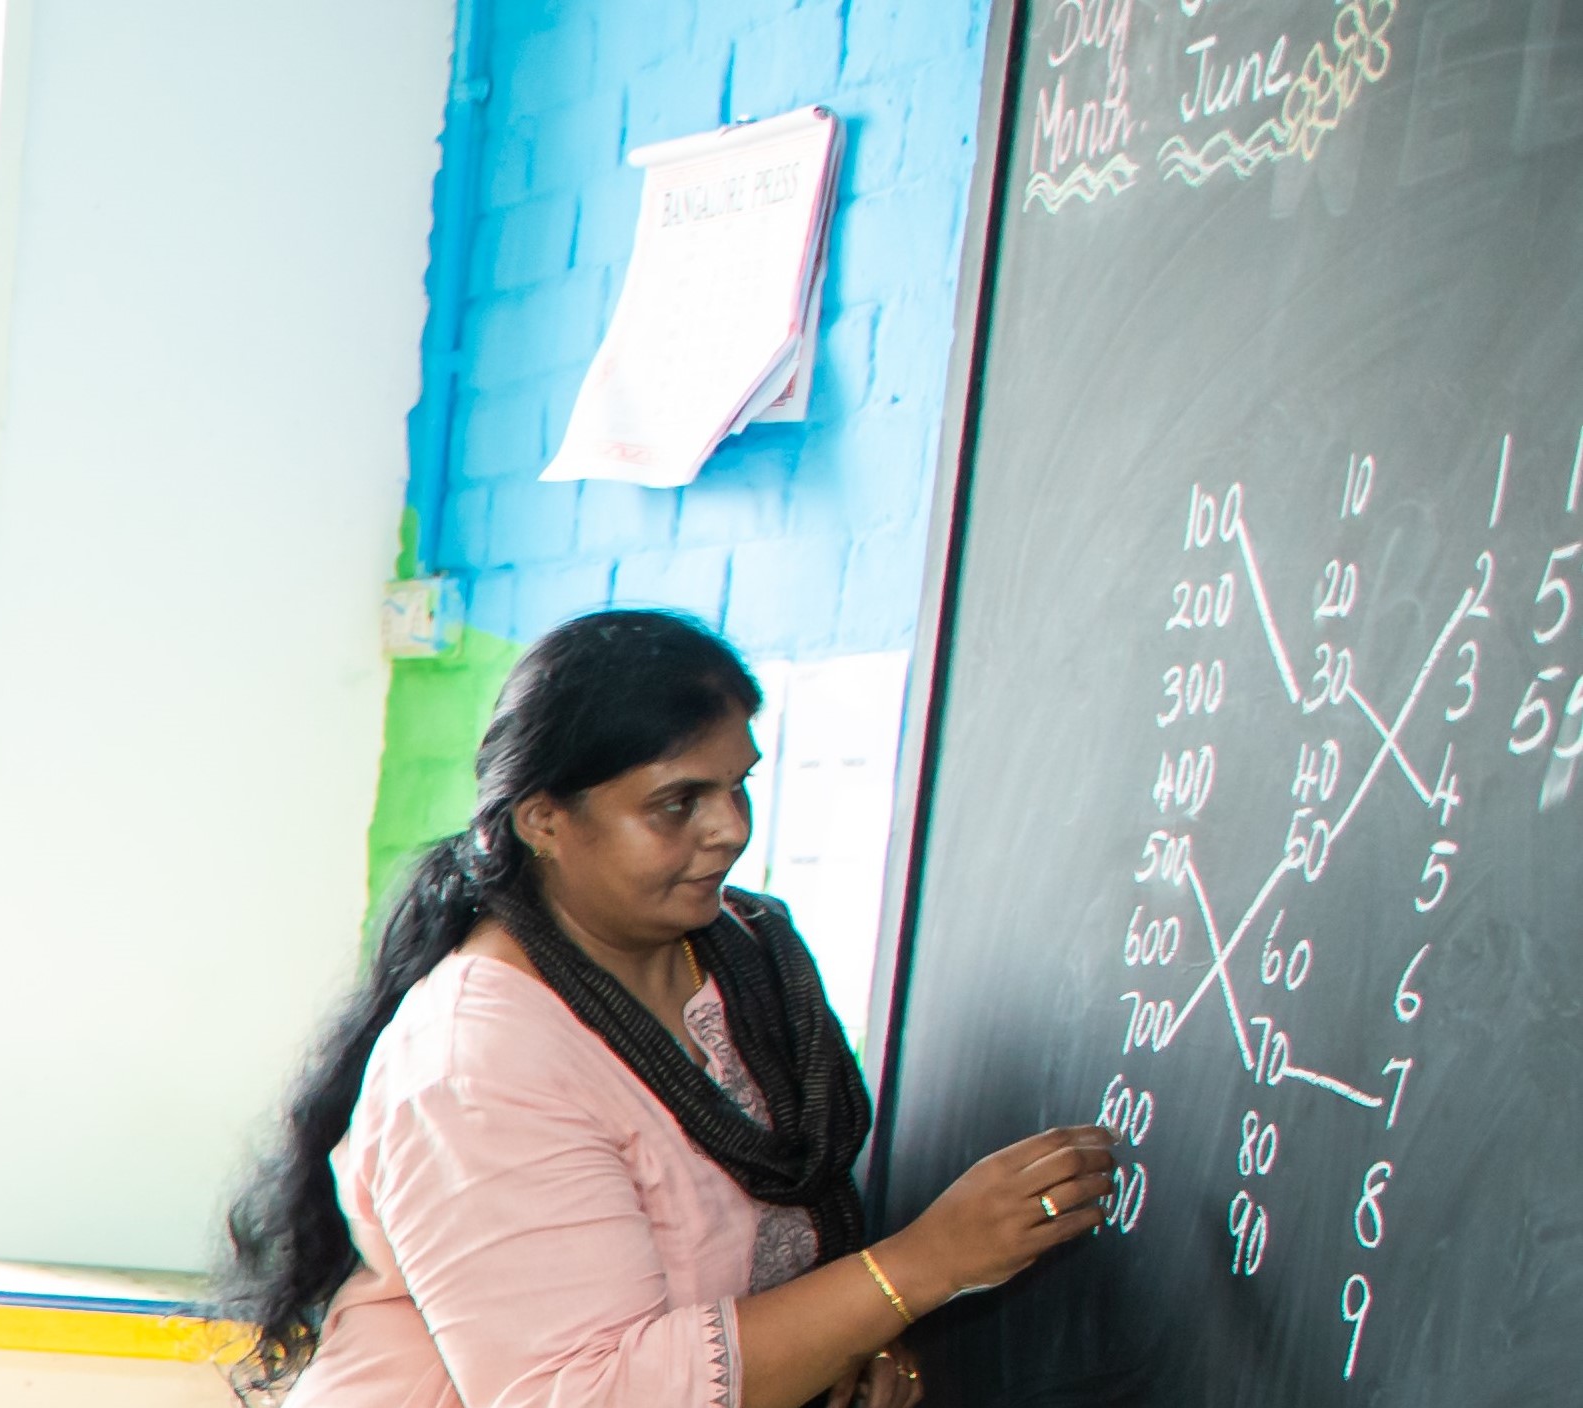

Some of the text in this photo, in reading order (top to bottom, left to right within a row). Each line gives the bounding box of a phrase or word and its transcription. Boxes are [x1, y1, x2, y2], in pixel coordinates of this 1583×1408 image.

[1180, 34, 1292, 122] June
[751, 160, 801, 209] PRESS
[1182, 481, 1244, 552] 100
[1339, 452, 1376, 519] 10
[1488, 432, 1513, 528] 1
[1164, 571, 1236, 632] 200
[1313, 558, 1358, 622] 20
[1466, 550, 1494, 618] 2
[1156, 658, 1226, 729] 300
[1301, 642, 1353, 714] 30
[1444, 639, 1480, 722] 3
[1152, 738, 1462, 827] 400 40 4
[1133, 807, 1459, 914] 500 50 5
[1124, 904, 1433, 1023] 600 60 6
[1119, 990, 1414, 1130] 700 70 7
[1237, 1110, 1280, 1179] 80
[1353, 1160, 1393, 1250] 8
[1227, 1189, 1270, 1277] 90
[1341, 1273, 1374, 1382] 9
